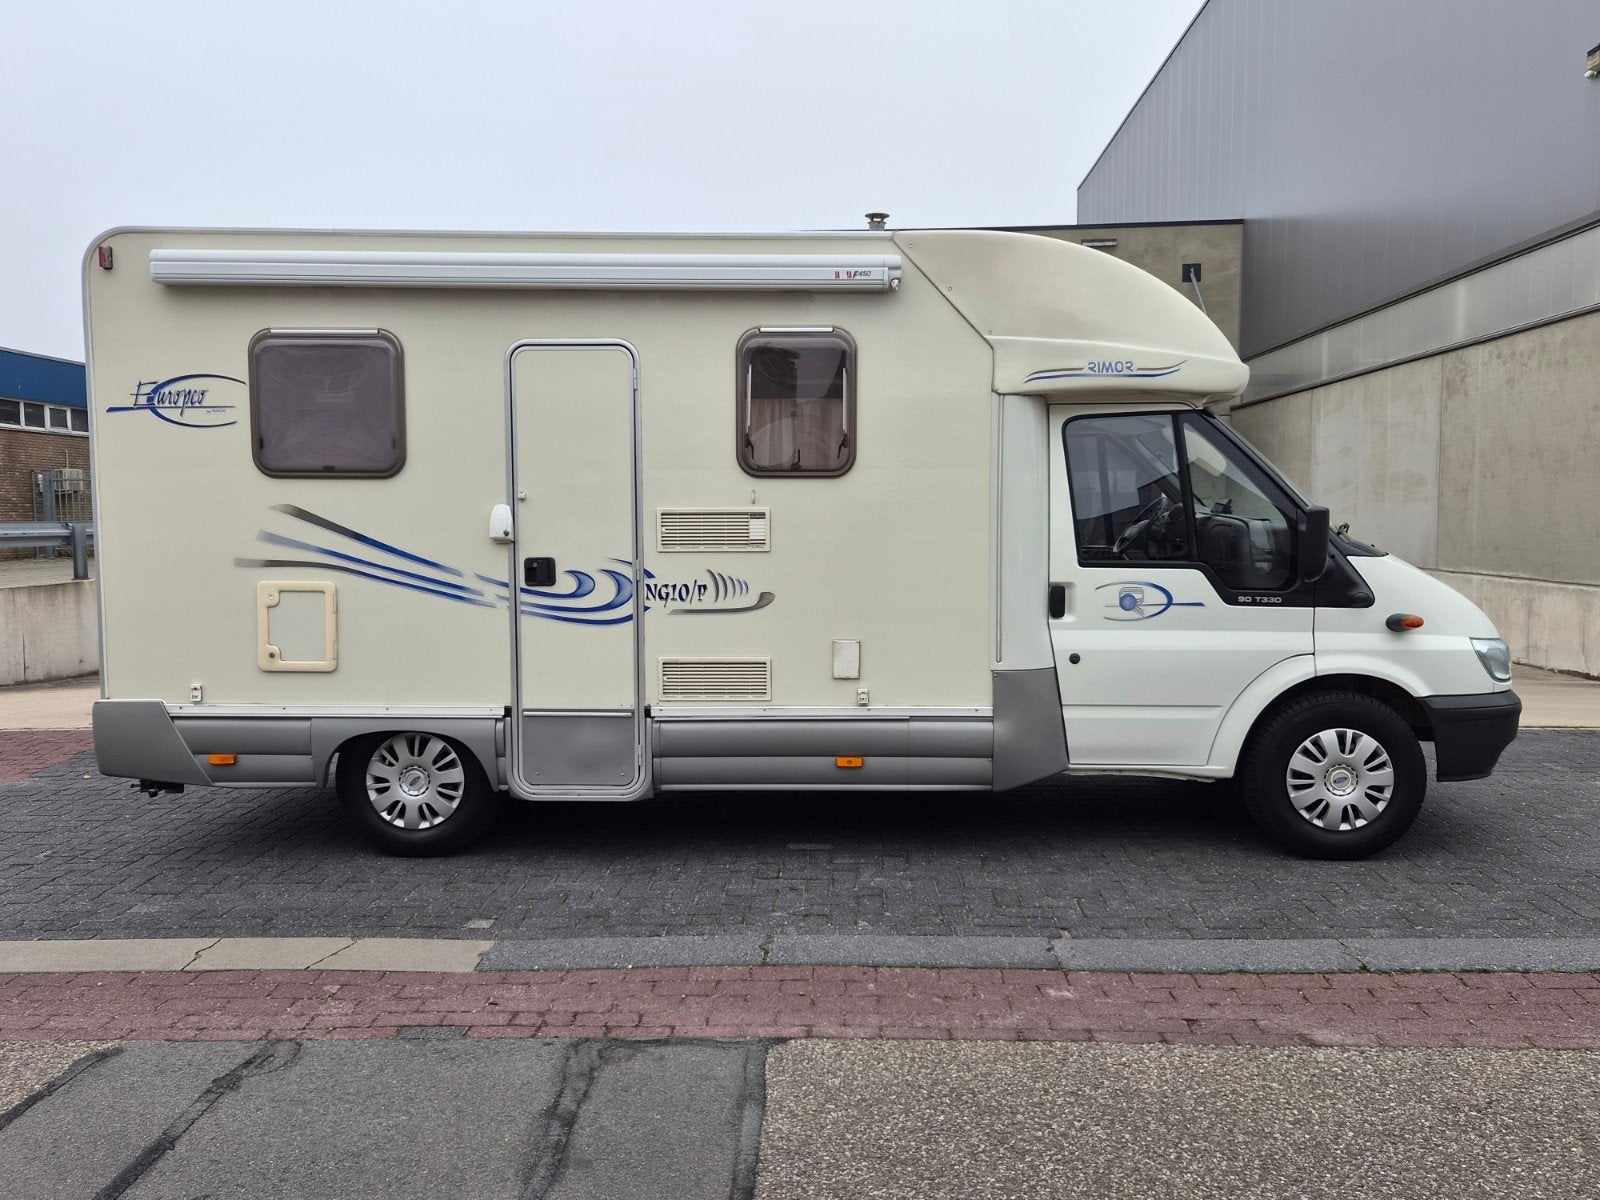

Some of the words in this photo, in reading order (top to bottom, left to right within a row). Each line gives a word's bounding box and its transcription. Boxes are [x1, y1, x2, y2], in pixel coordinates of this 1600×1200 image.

[1087, 361, 1134, 373] RIMOR
[1237, 595, 1252, 603] 90
[1254, 596, 1282, 604] T330
